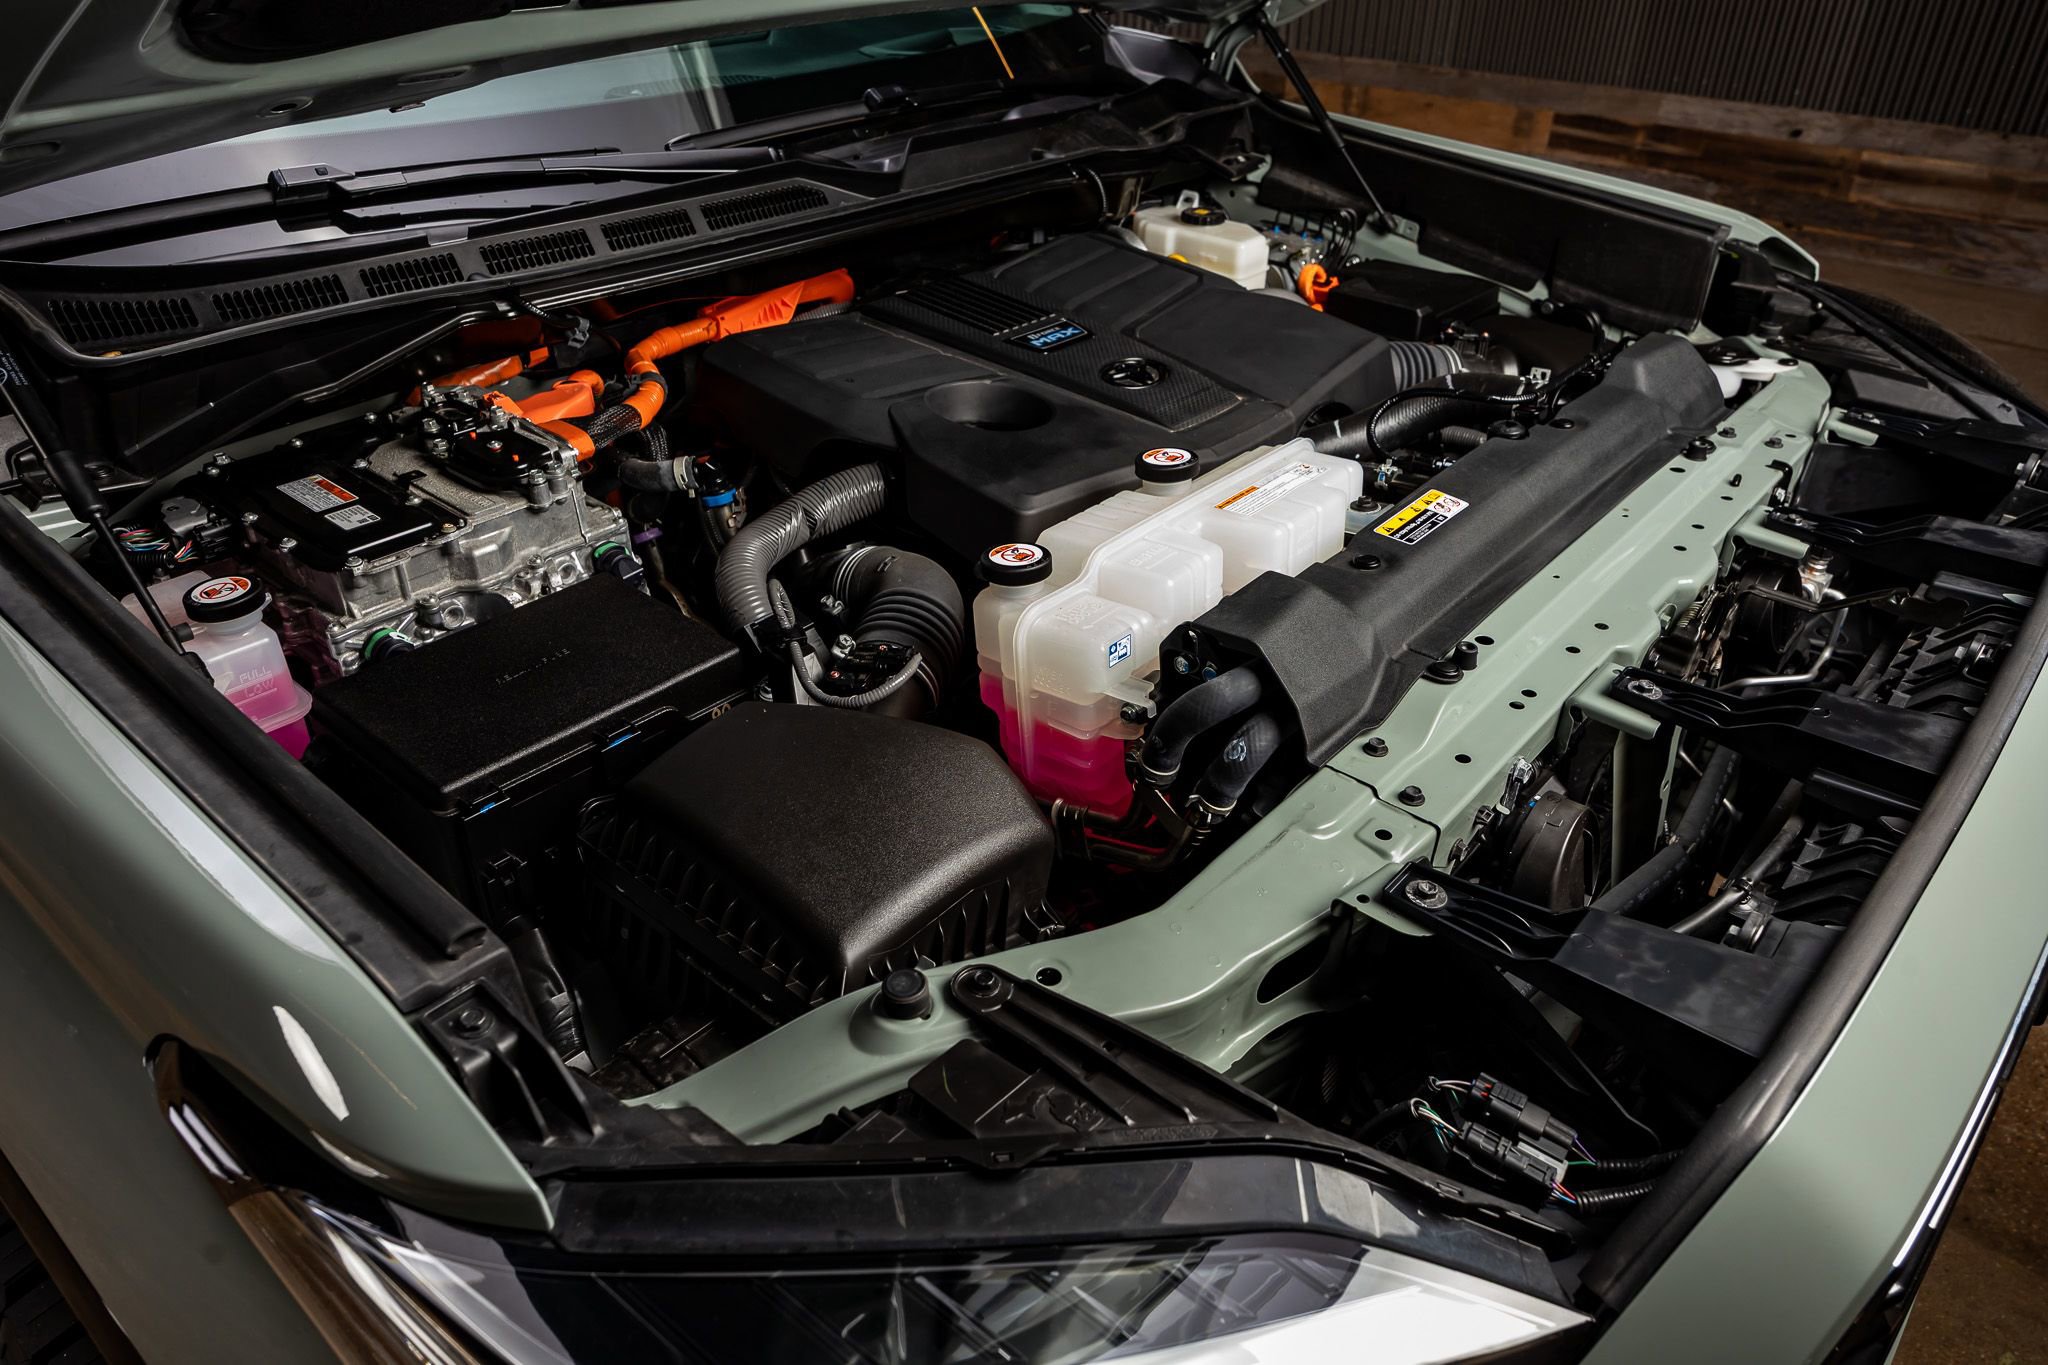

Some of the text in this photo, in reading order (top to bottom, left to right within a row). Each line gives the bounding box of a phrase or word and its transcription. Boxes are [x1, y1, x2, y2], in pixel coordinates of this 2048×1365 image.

[1030, 326, 1081, 346] MAX
[240, 666, 272, 684] FULL
[245, 678, 274, 698] LOW
